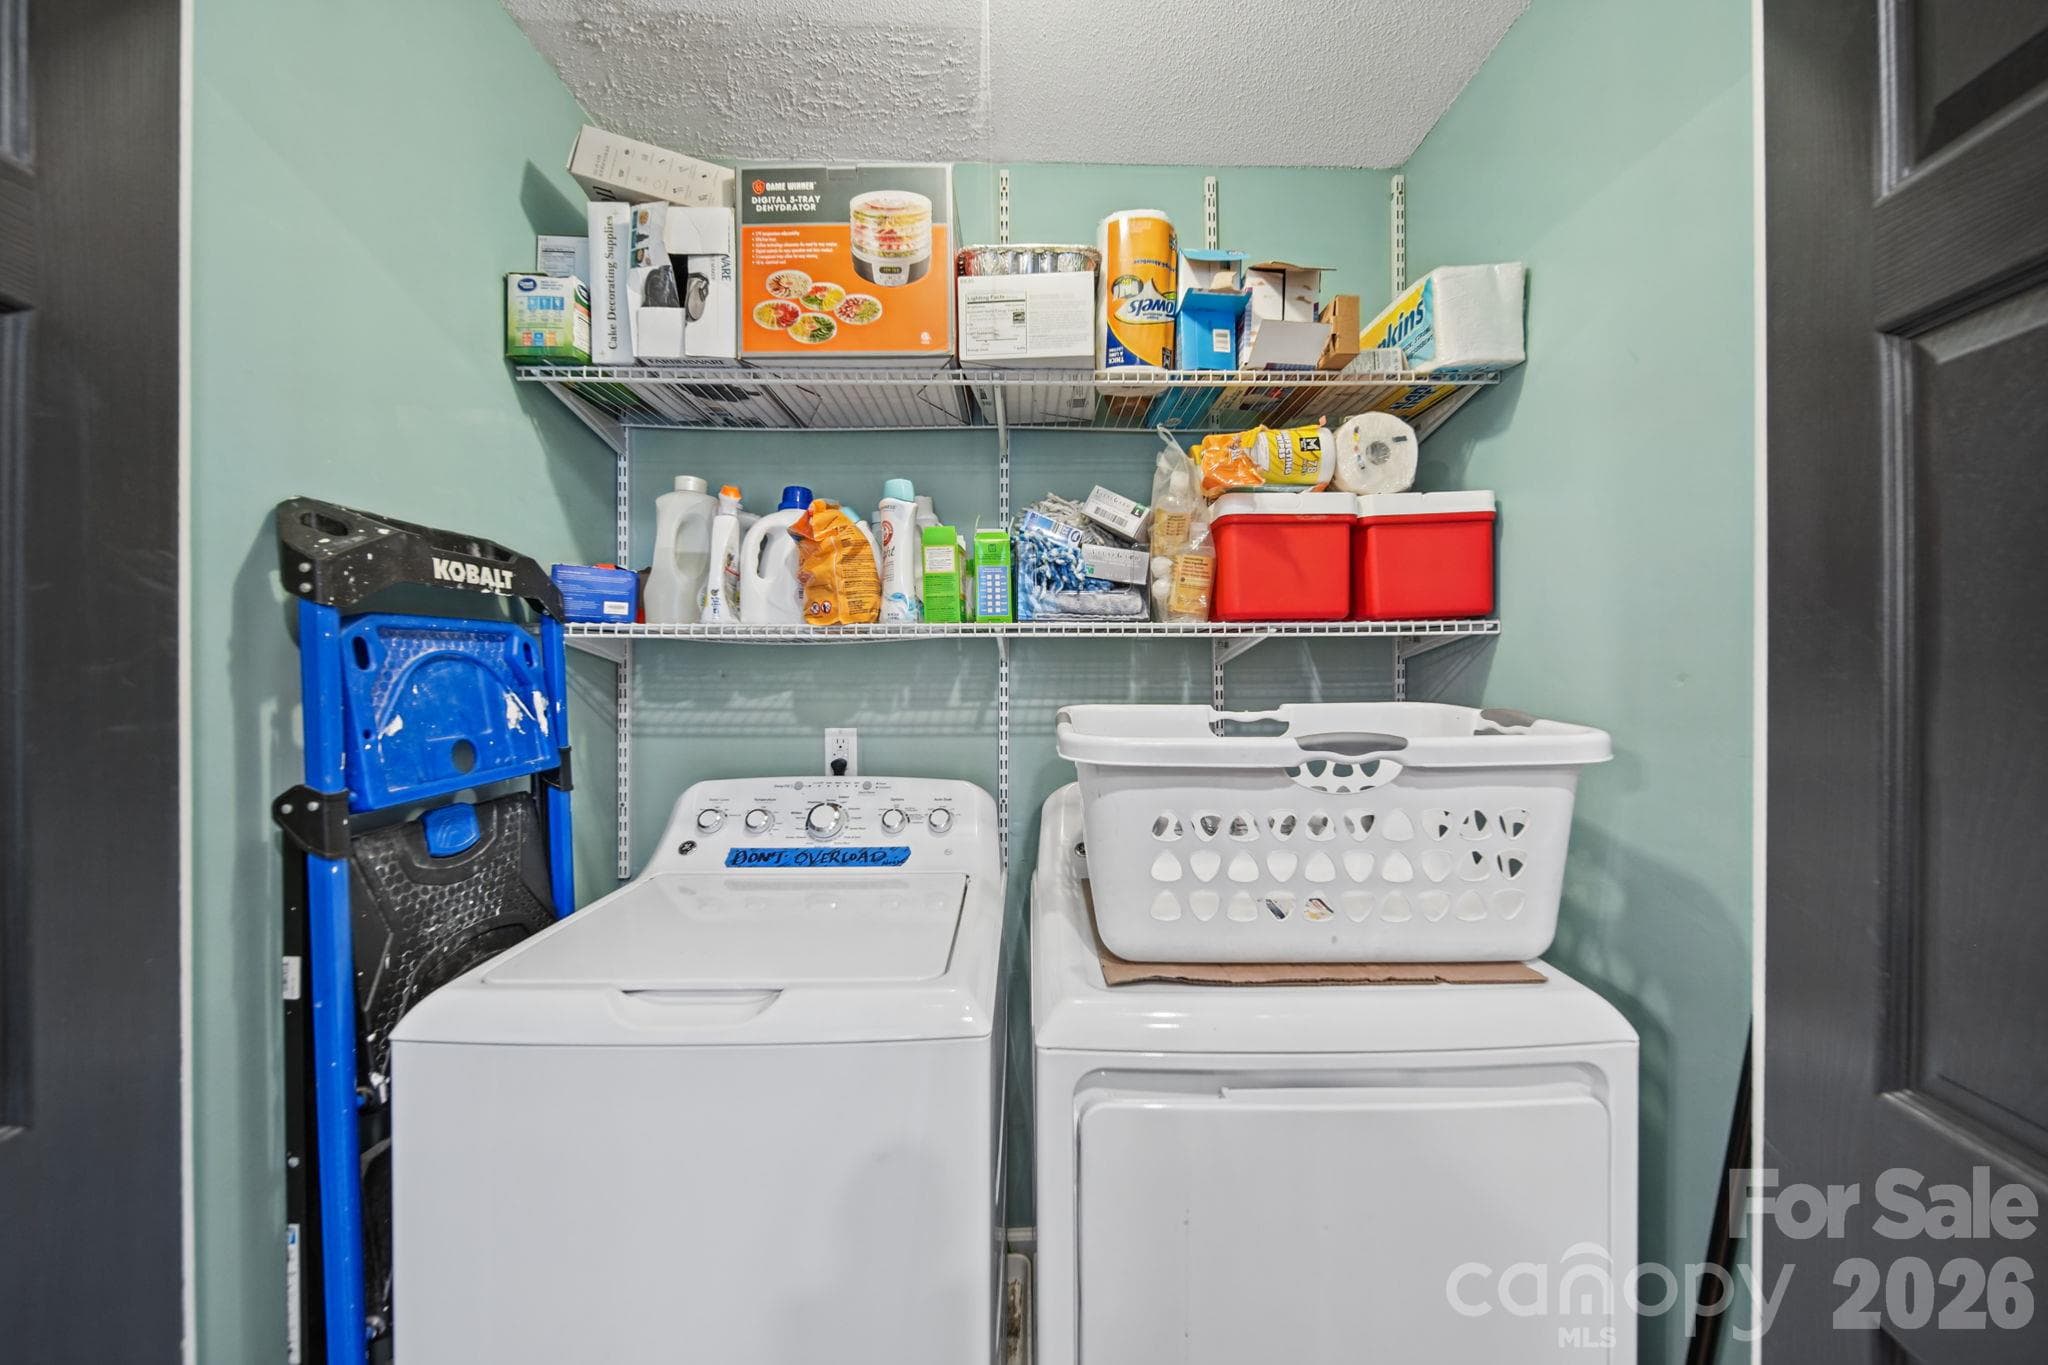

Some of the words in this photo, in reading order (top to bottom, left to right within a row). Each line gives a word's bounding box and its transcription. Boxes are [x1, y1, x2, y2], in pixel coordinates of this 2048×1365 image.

[765, 181, 786, 192] GAME
[751, 196, 788, 205] DIGITAL
[755, 203, 817, 213] DEHYDRATOR
[605, 215, 617, 259] Supplies
[606, 259, 618, 315] Decorating
[1128, 299, 1177, 318] Towels
[606, 317, 619, 351] Cake
[1306, 460, 1318, 474] 78
[431, 557, 514, 590] KOBALT
[793, 849, 888, 867] OVERLOAD
